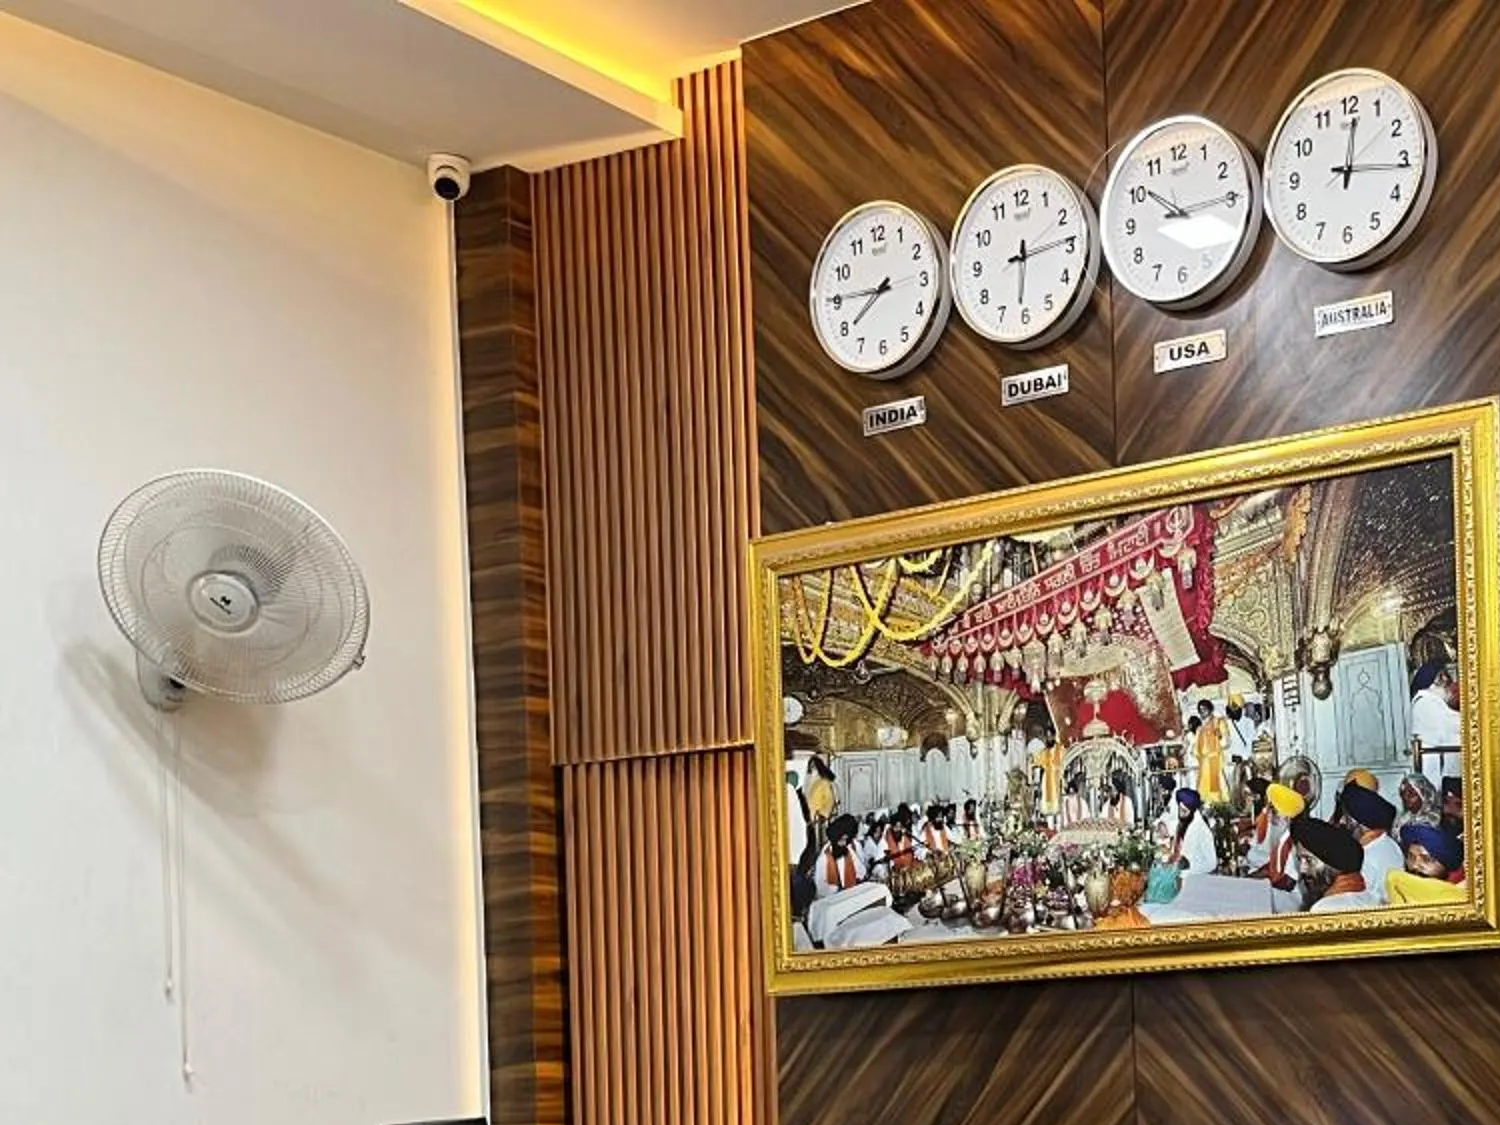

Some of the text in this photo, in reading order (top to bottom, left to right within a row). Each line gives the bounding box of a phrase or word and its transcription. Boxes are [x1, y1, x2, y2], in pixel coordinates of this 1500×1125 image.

[1341, 96, 1359, 115] 12
[1374, 99, 1381, 117] 1
[1314, 110, 1330, 129] 11
[1392, 120, 1402, 138] 2
[1170, 144, 1187, 161] 12
[1200, 144, 1207, 160] 1
[1294, 138, 1312, 157] 10
[1147, 158, 1161, 176] 11
[1399, 150, 1410, 167] 3
[1218, 162, 1228, 180] 2
[1289, 172, 1299, 190] 9
[1014, 189, 1029, 207] 12
[1041, 192, 1048, 207] 1
[1130, 186, 1146, 204] 10
[1390, 184, 1400, 201] 4
[992, 203, 1005, 220] 11
[1058, 209, 1067, 225] 2
[1296, 203, 1307, 220] 8
[1126, 219, 1136, 235] 9
[1370, 212, 1381, 230] 5
[870, 226, 885, 242] 12
[897, 227, 903, 242] 1
[976, 230, 991, 248] 10
[1316, 222, 1326, 240] 7
[1343, 226, 1353, 243] 6
[851, 239, 863, 256] 11
[912, 244, 921, 260] 2
[1066, 237, 1075, 254] 3
[1133, 247, 1143, 264] 8
[836, 264, 850, 281] 10
[973, 262, 982, 277] 9
[1060, 268, 1069, 284] 4
[1152, 264, 1162, 281] 7
[1178, 267, 1188, 283] 6
[919, 271, 928, 287] 3
[833, 294, 842, 310] 9
[980, 289, 989, 305] 8
[1044, 294, 1053, 311] 5
[916, 301, 923, 316] 4
[998, 306, 1006, 322] 7
[1022, 308, 1030, 324] 6
[1321, 300, 1387, 328] AUSTRALIA
[840, 322, 848, 337] 8
[900, 326, 909, 342] 5
[857, 338, 865, 353] 7
[879, 340, 887, 355] 6
[1169, 341, 1210, 361] USA
[1008, 372, 1062, 398] DUBAI
[870, 405, 918, 428] INDIA
